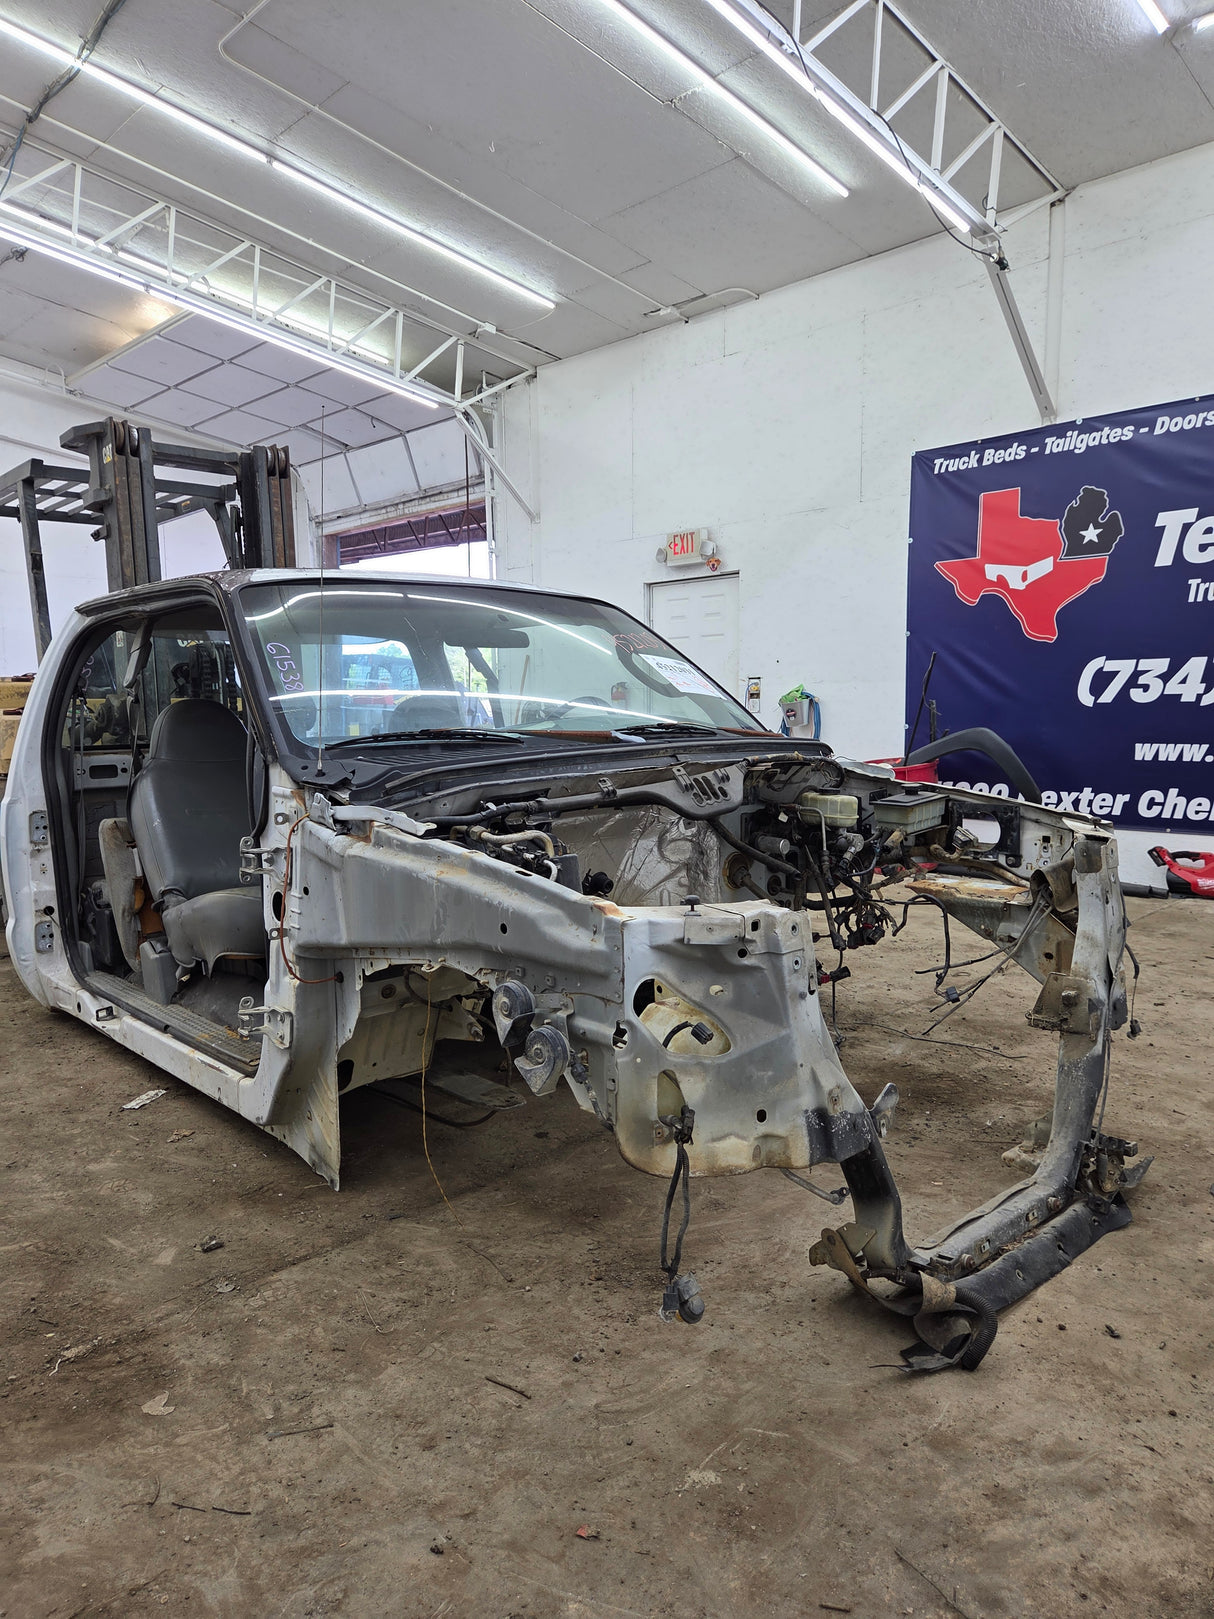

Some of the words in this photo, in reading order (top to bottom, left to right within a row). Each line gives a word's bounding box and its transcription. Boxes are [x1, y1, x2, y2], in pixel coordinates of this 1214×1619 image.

[933, 450, 980, 475] Truck
[982, 442, 1027, 467] Beds
[1044, 424, 1134, 455] Tailgates
[1153, 410, 1214, 436] Doors
[673, 531, 695, 555] EXIT
[266, 642, 304, 691] 61538
[1134, 743, 1214, 763] www.
[1018, 787, 1130, 816] exter
